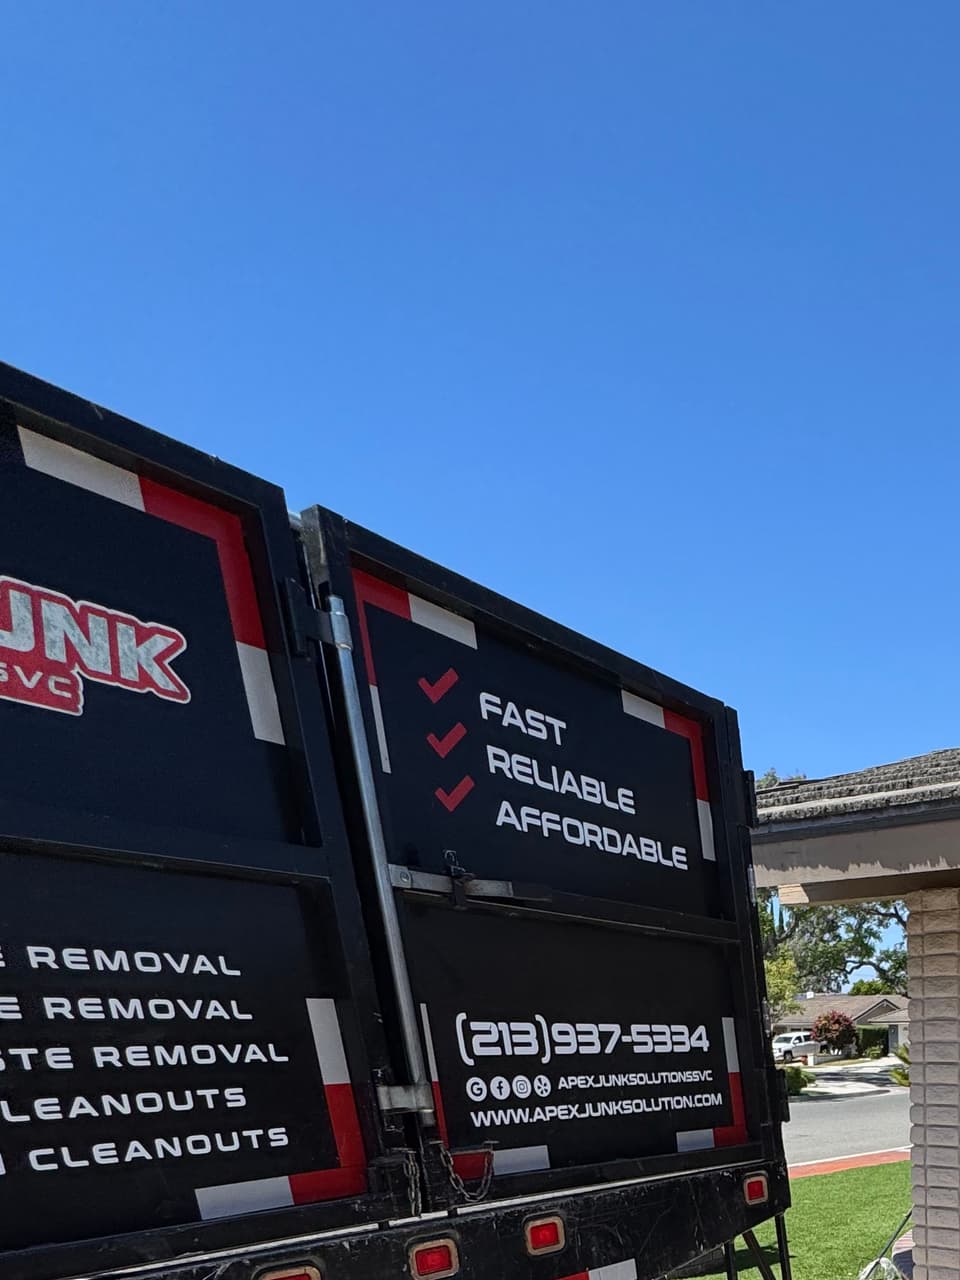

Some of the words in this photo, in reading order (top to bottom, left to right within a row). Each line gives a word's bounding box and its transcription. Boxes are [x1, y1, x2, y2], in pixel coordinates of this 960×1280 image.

[479, 692, 566, 745] FAST
[486, 745, 636, 815] RELIABLE
[496, 800, 689, 870] AFFORDABLE
[26, 946, 241, 976] REMOVAL
[43, 997, 253, 1020] REMOVAL
[93, 1044, 289, 1068] REMOVAL
[456, 1012, 710, 1066] (213)937-5334
[558, 1070, 713, 1090] APEXJUNKSOLUTIONSSVC
[470, 1093, 723, 1128] WWW.APEXJUNKSOLUTION.COM
[29, 1127, 289, 1171] CLEANOUTS
